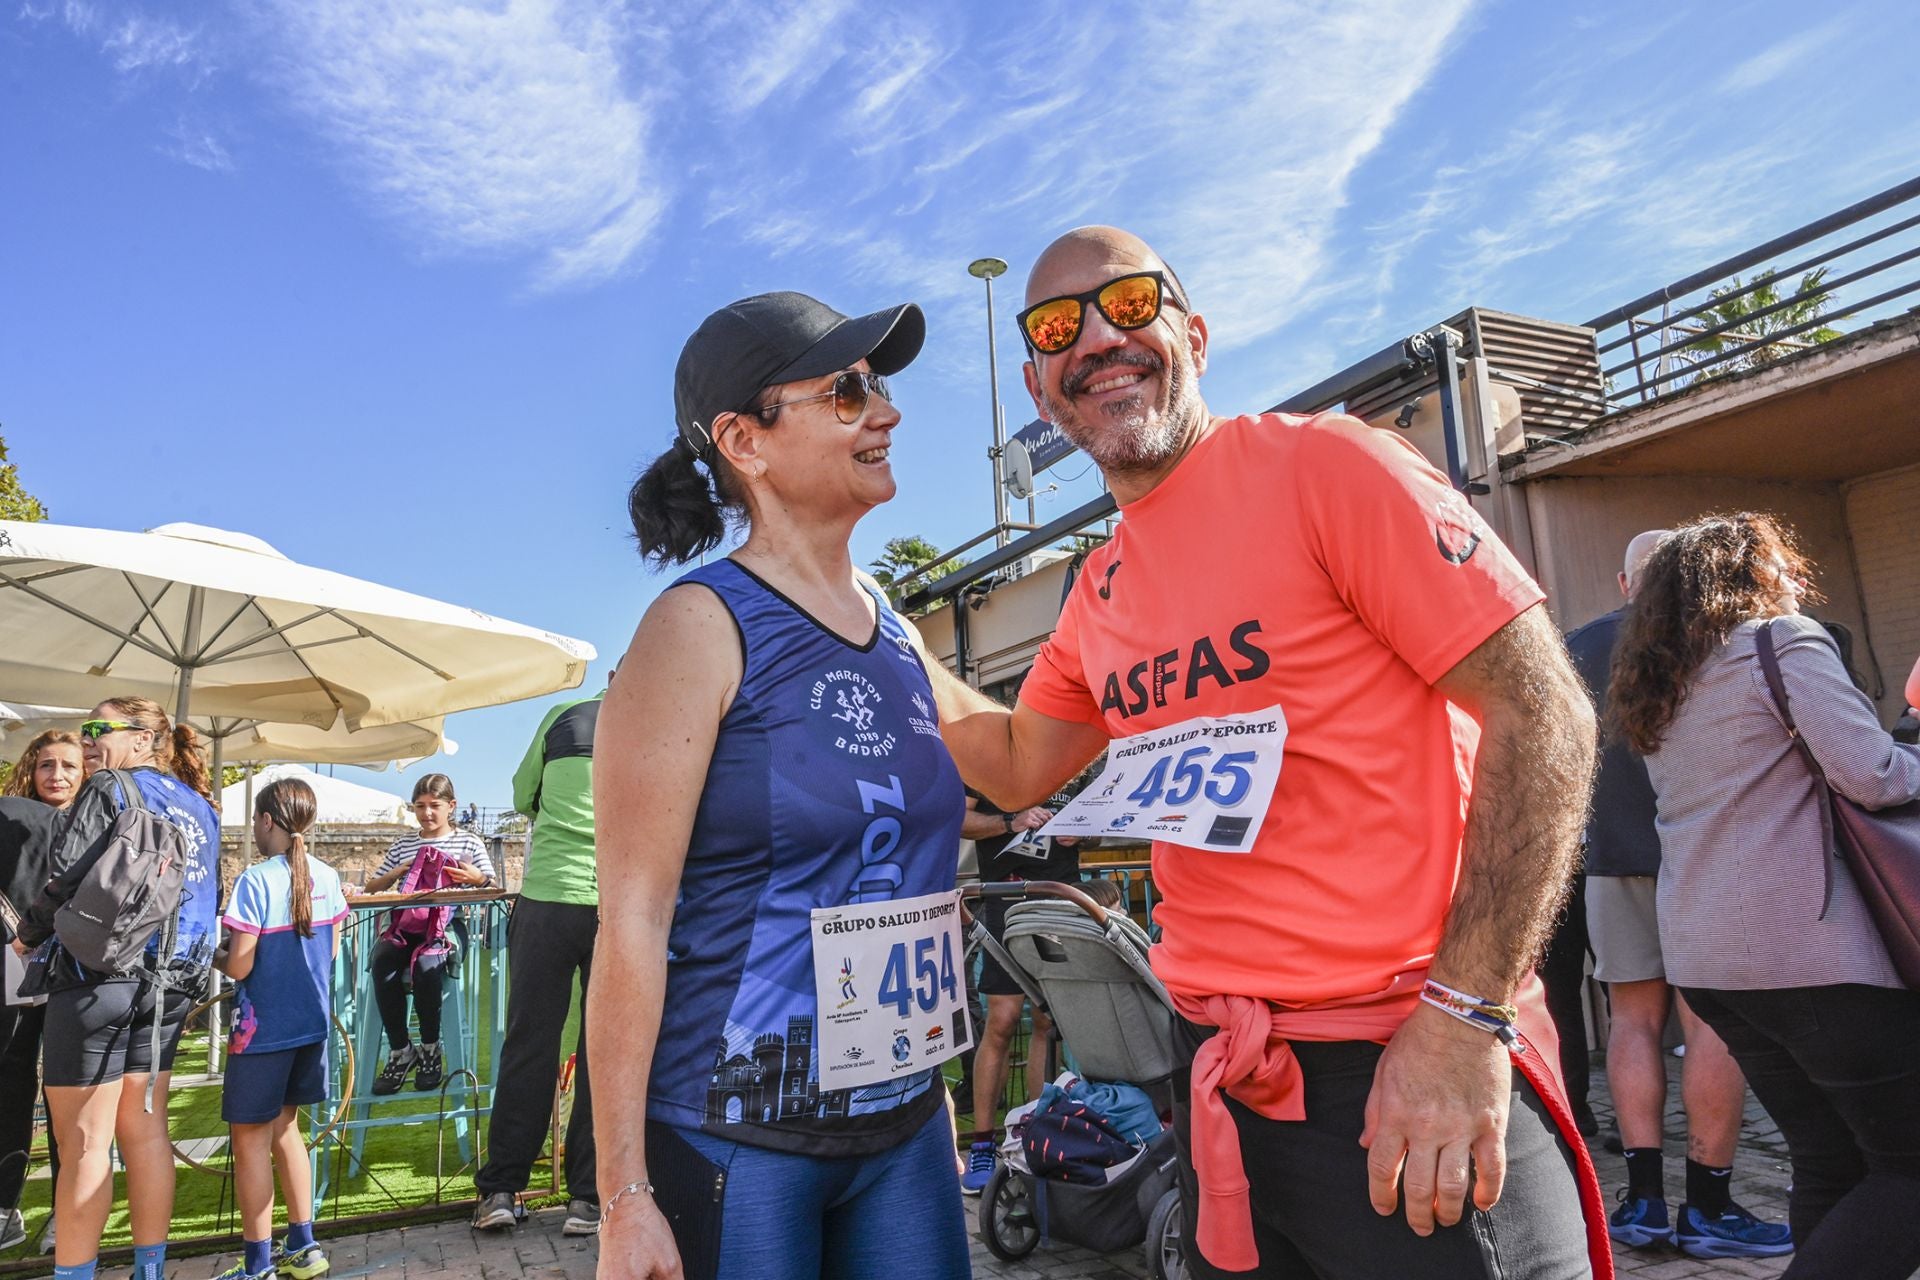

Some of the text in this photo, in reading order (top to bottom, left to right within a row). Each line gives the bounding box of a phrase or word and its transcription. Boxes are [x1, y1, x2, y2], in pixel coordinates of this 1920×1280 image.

[1101, 620, 1270, 719] ASFAS
[811, 669, 883, 711] CLUB MARATON
[835, 732, 896, 758] BADAJOZ
[855, 732, 880, 743] 1989
[1116, 720, 1278, 760] GRUPO SALUD Y EPORTE
[1127, 745, 1258, 809] 455
[1147, 824, 1182, 833] aacb.es
[822, 917, 876, 935] GRUPO
[878, 910, 921, 928] SALUD
[922, 909, 929, 921] Y
[878, 931, 958, 1019] 454
[925, 1043, 945, 1056] aacb.es
